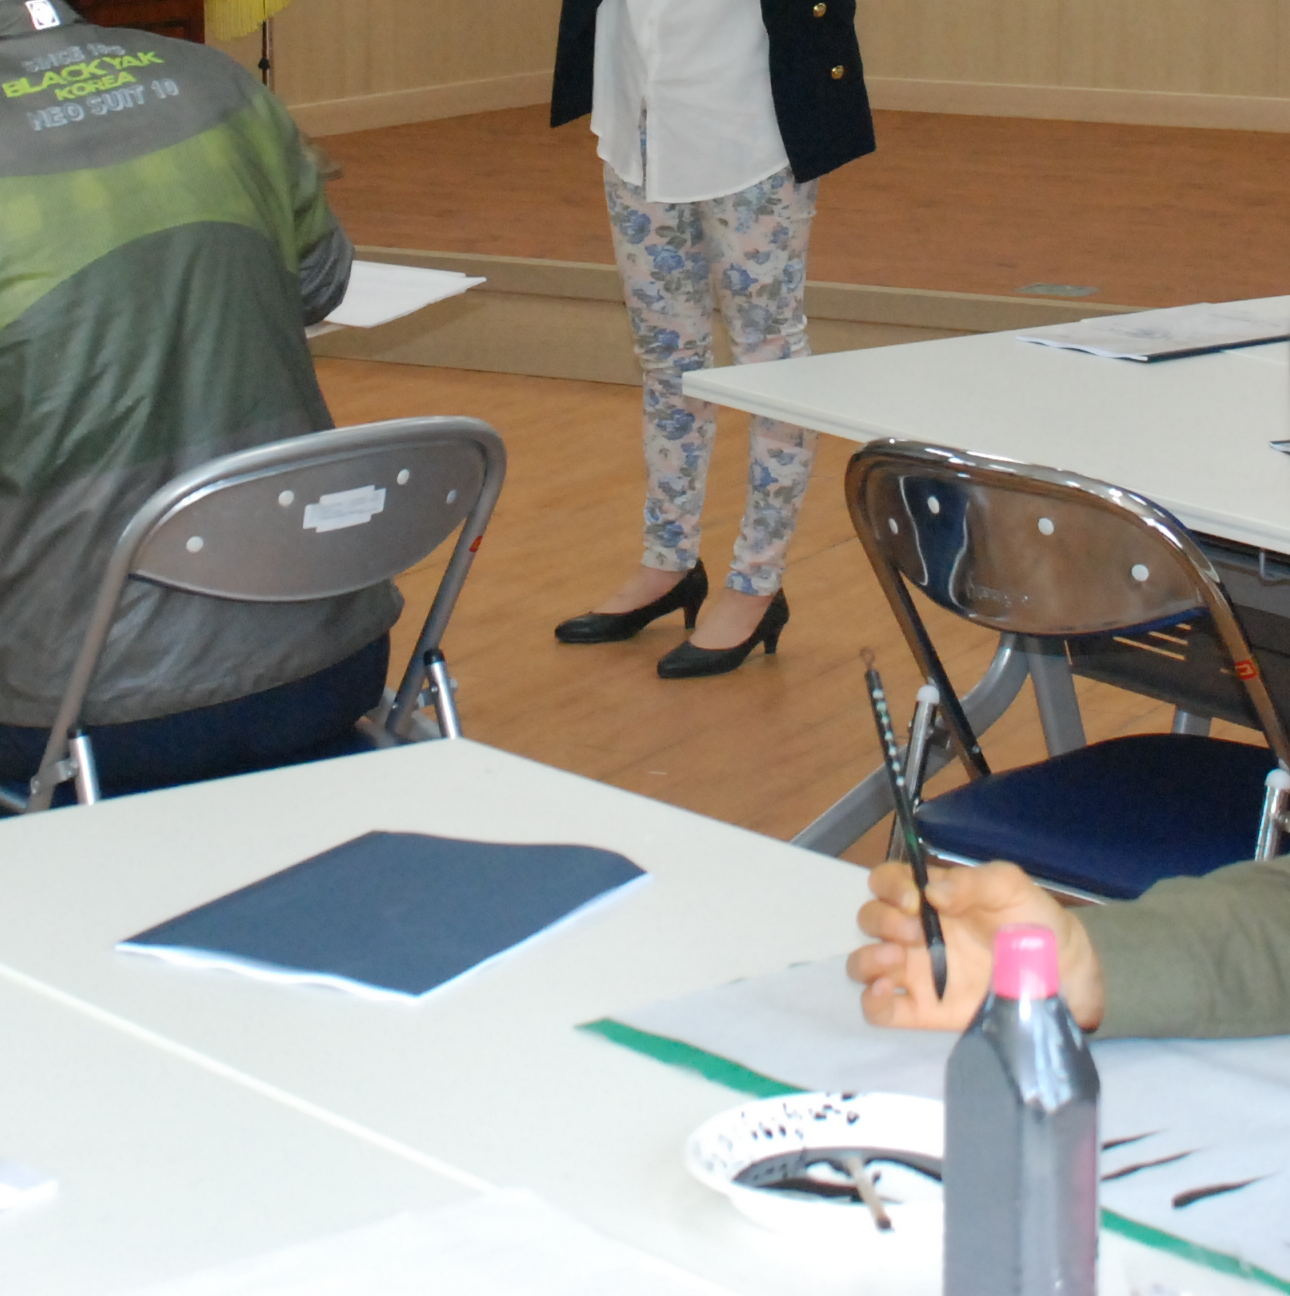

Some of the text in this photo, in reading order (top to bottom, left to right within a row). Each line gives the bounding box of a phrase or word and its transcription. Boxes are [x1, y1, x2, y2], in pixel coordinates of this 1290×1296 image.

[54, 70, 138, 102] KOREA
[26, 102, 85, 132] NEO
[86, 84, 145, 116] SUIT
